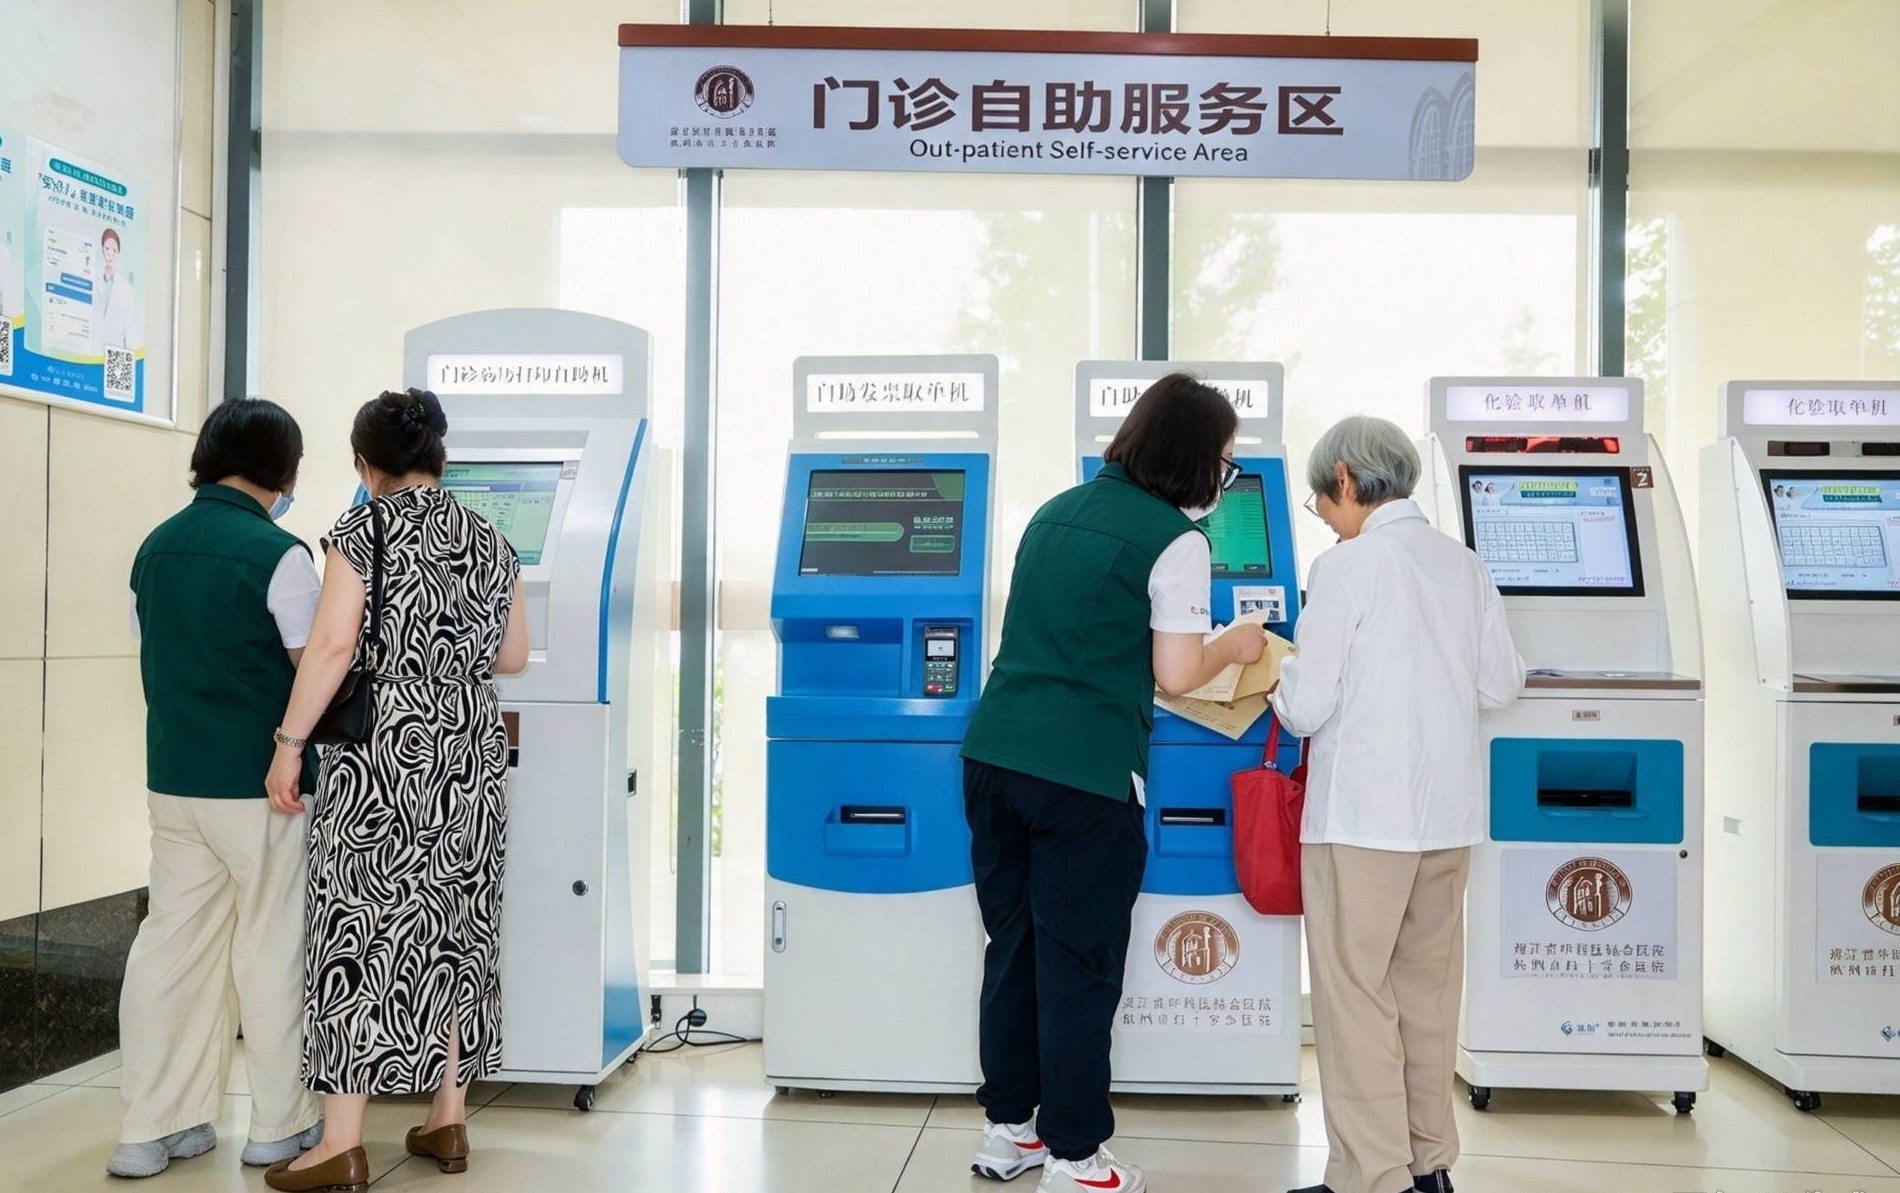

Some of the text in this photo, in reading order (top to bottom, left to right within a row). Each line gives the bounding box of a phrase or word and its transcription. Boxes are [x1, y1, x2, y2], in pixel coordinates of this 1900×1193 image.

[813, 75, 1344, 136] 门诊自助服务区
[909, 139, 1248, 163] Out-patient Self-service Area
[1637, 472, 1648, 487] 2
